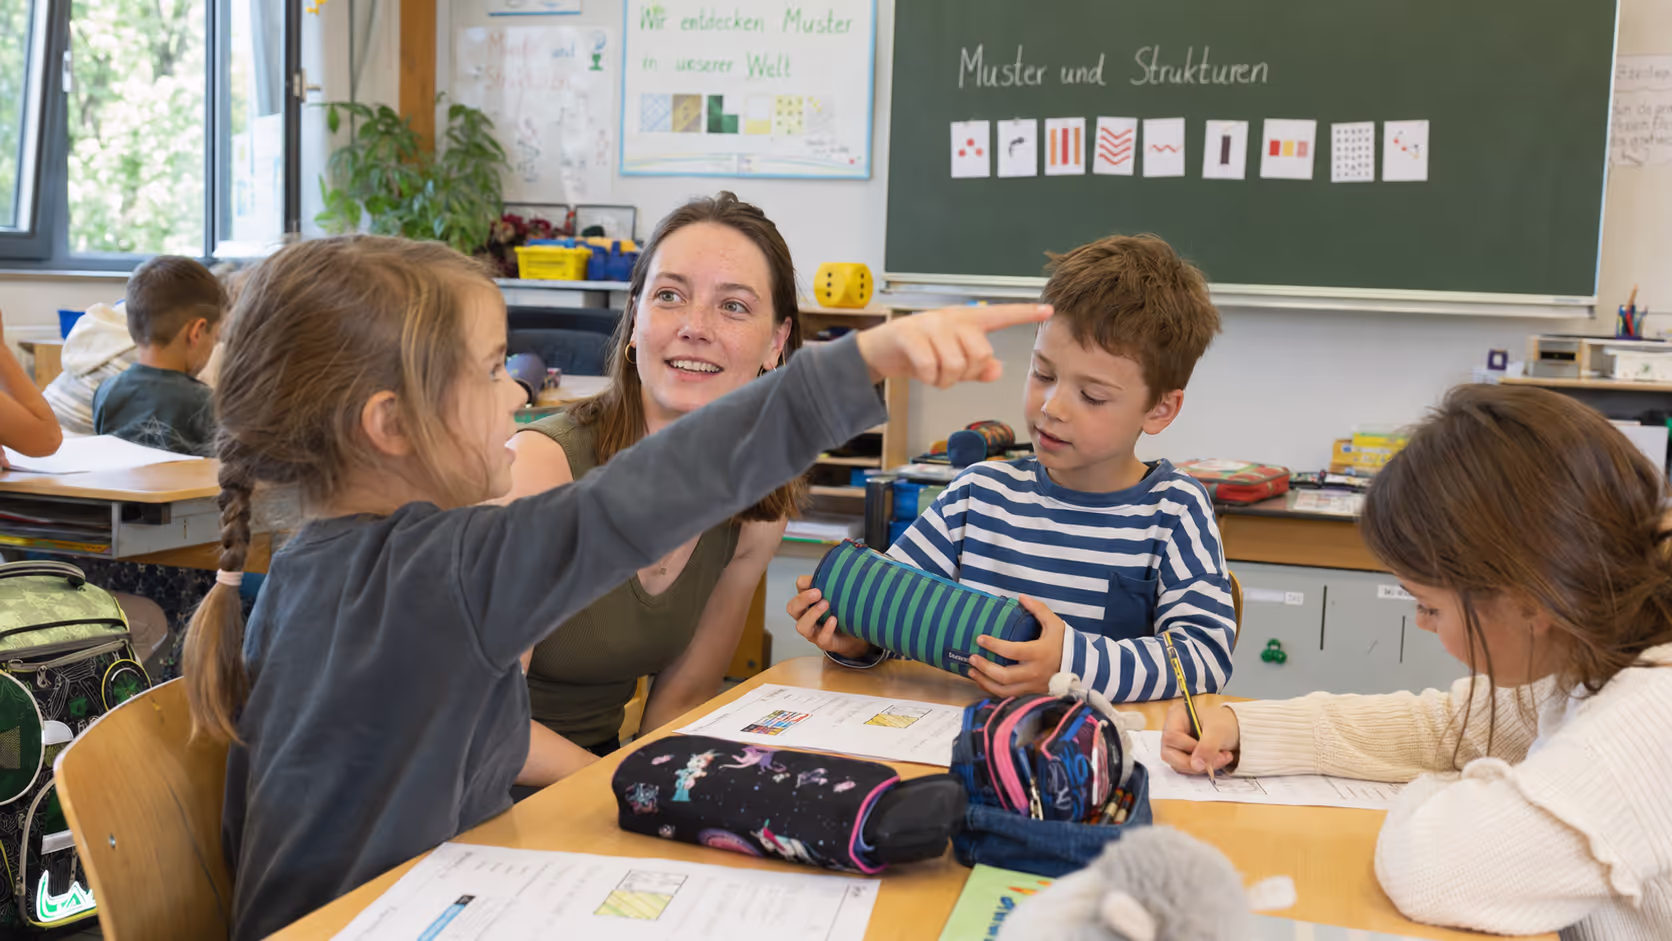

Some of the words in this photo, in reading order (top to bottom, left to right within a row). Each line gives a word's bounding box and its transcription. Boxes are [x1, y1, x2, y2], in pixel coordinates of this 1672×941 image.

[639, 4, 665, 31] Wir
[680, 7, 764, 32] entdecken
[782, 5, 853, 34] Muster
[641, 53, 658, 72] in
[674, 57, 734, 73] unserer
[746, 52, 791, 78] Welt
[958, 44, 1046, 89] Muster
[1060, 53, 1106, 86] und
[1130, 45, 1268, 86] Strukturen
